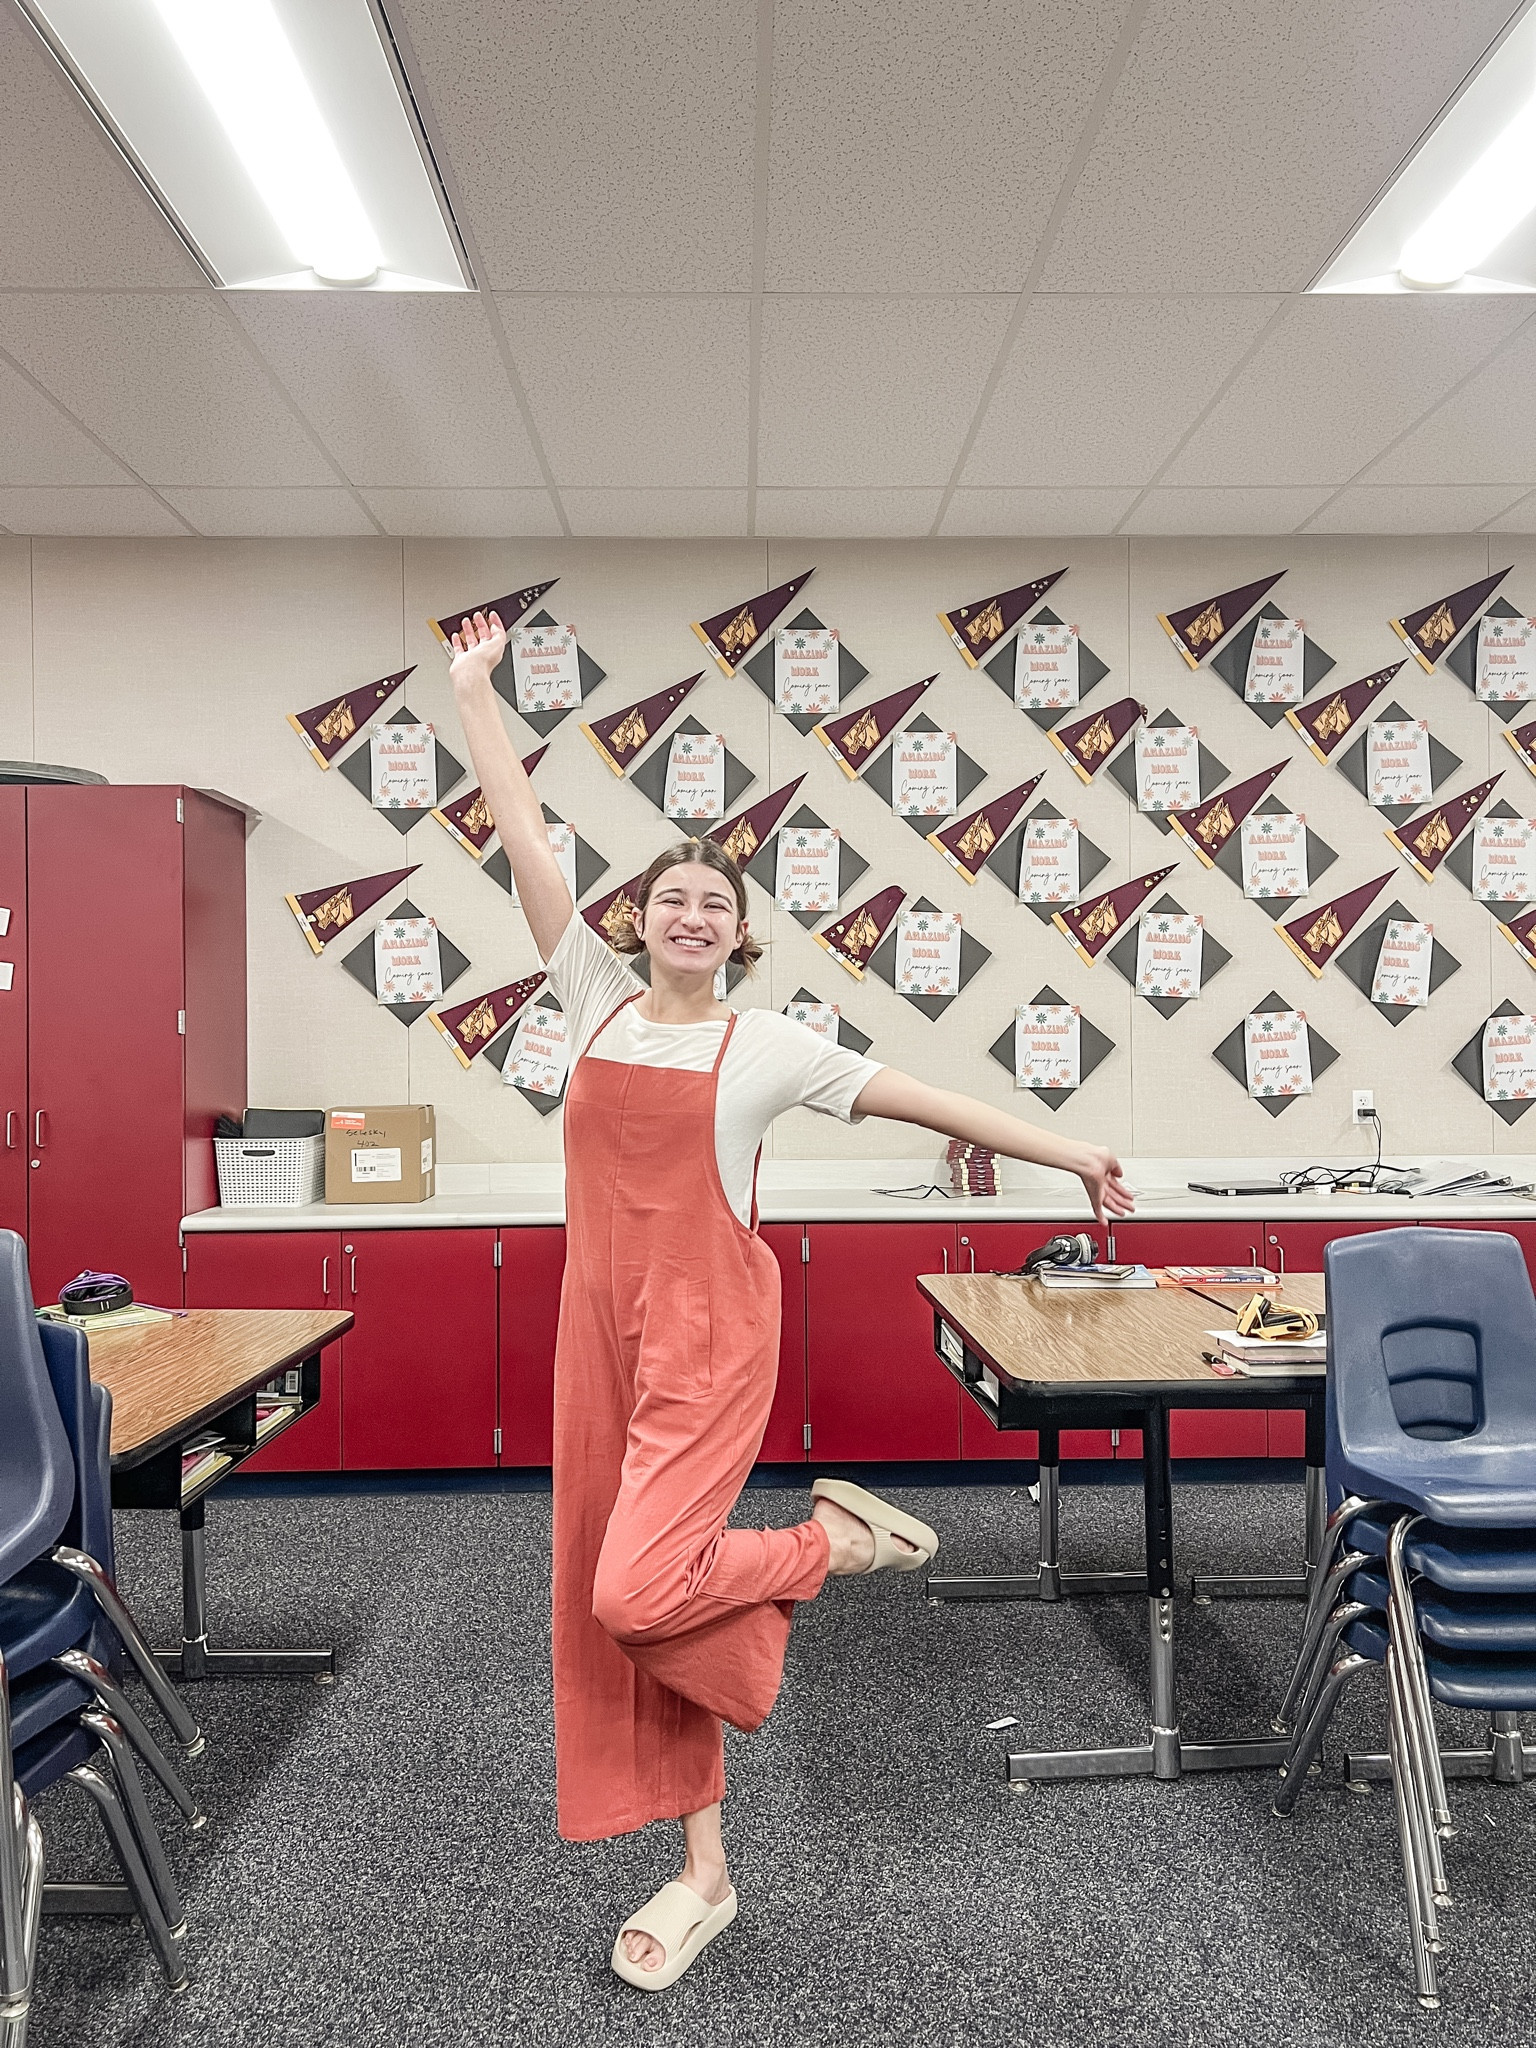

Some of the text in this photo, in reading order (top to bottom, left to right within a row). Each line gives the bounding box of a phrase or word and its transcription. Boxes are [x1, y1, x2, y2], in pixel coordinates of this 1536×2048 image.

[1483, 637, 1526, 647] AMAZING
[521, 645, 566, 658] AMAZING
[782, 649, 828, 659] AMAZING
[1023, 644, 1067, 654] AMAZING
[1256, 655, 1283, 666] WORK
[1489, 654, 1516, 664] WORK
[531, 663, 560, 674] WORK
[791, 666, 819, 676] WORK
[1030, 661, 1058, 671] WORK
[1278, 671, 1294, 681] soon
[1482, 664, 1528, 684] Coming soon
[525, 676, 572, 694] Coming soon
[784, 677, 830, 696] Coming soon
[1023, 672, 1070, 691] Coming soon
[379, 744, 425, 754] AMAZING
[1373, 740, 1417, 752] AMAZING
[900, 752, 945, 762] AMAZING
[1143, 747, 1187, 757] AMAZING
[672, 753, 713, 764] AMAZING
[1381, 759, 1409, 768] WORK
[388, 761, 417, 770] WORK
[1151, 764, 1179, 774] WORK
[678, 771, 705, 781] WORK
[909, 769, 937, 779] WORK
[1374, 769, 1422, 787] Coming soon
[381, 772, 428, 791] Coming soon
[1145, 775, 1191, 793] Coming soon
[671, 781, 716, 801] Coming soon
[901, 779, 948, 799] Coming soon
[1249, 834, 1295, 844] AMAZING
[1480, 836, 1526, 847] AMAZING
[784, 848, 828, 857] AMAZING
[1258, 851, 1287, 860] WORK
[1031, 856, 1059, 866] WORK
[1488, 854, 1517, 864] WORK
[792, 864, 819, 874] WORK
[1251, 862, 1298, 880] Coming soon
[1481, 864, 1528, 884] Coming soon
[1025, 866, 1070, 885] Coming soon
[784, 875, 830, 894] Coming soon
[904, 931, 950, 941] AMAZING
[1146, 932, 1191, 944] AMAZING
[382, 938, 428, 950] AMAZING
[912, 948, 940, 958] WORK
[1153, 949, 1181, 960] WORK
[392, 955, 421, 966] WORK
[1383, 956, 1409, 968] WORK
[904, 958, 951, 978] Coming soon
[1145, 960, 1192, 980] Coming soon
[385, 967, 433, 985] Coming soon
[1379, 973, 1420, 986] oming soon
[522, 1023, 565, 1042] AMAZING
[1024, 1024, 1069, 1035] AMAZING
[1251, 1031, 1297, 1043] AMAZING
[1488, 1035, 1531, 1047] AMAZING
[524, 1040, 552, 1057] WORK
[1032, 1042, 1060, 1052] WORK
[1260, 1048, 1289, 1060] WORK
[1495, 1053, 1523, 1063] WORK
[514, 1050, 558, 1072] Coming soon
[1024, 1051, 1071, 1070] Coming soon
[1254, 1060, 1302, 1079] Coming soon
[1490, 1064, 1516, 1082] Coming
